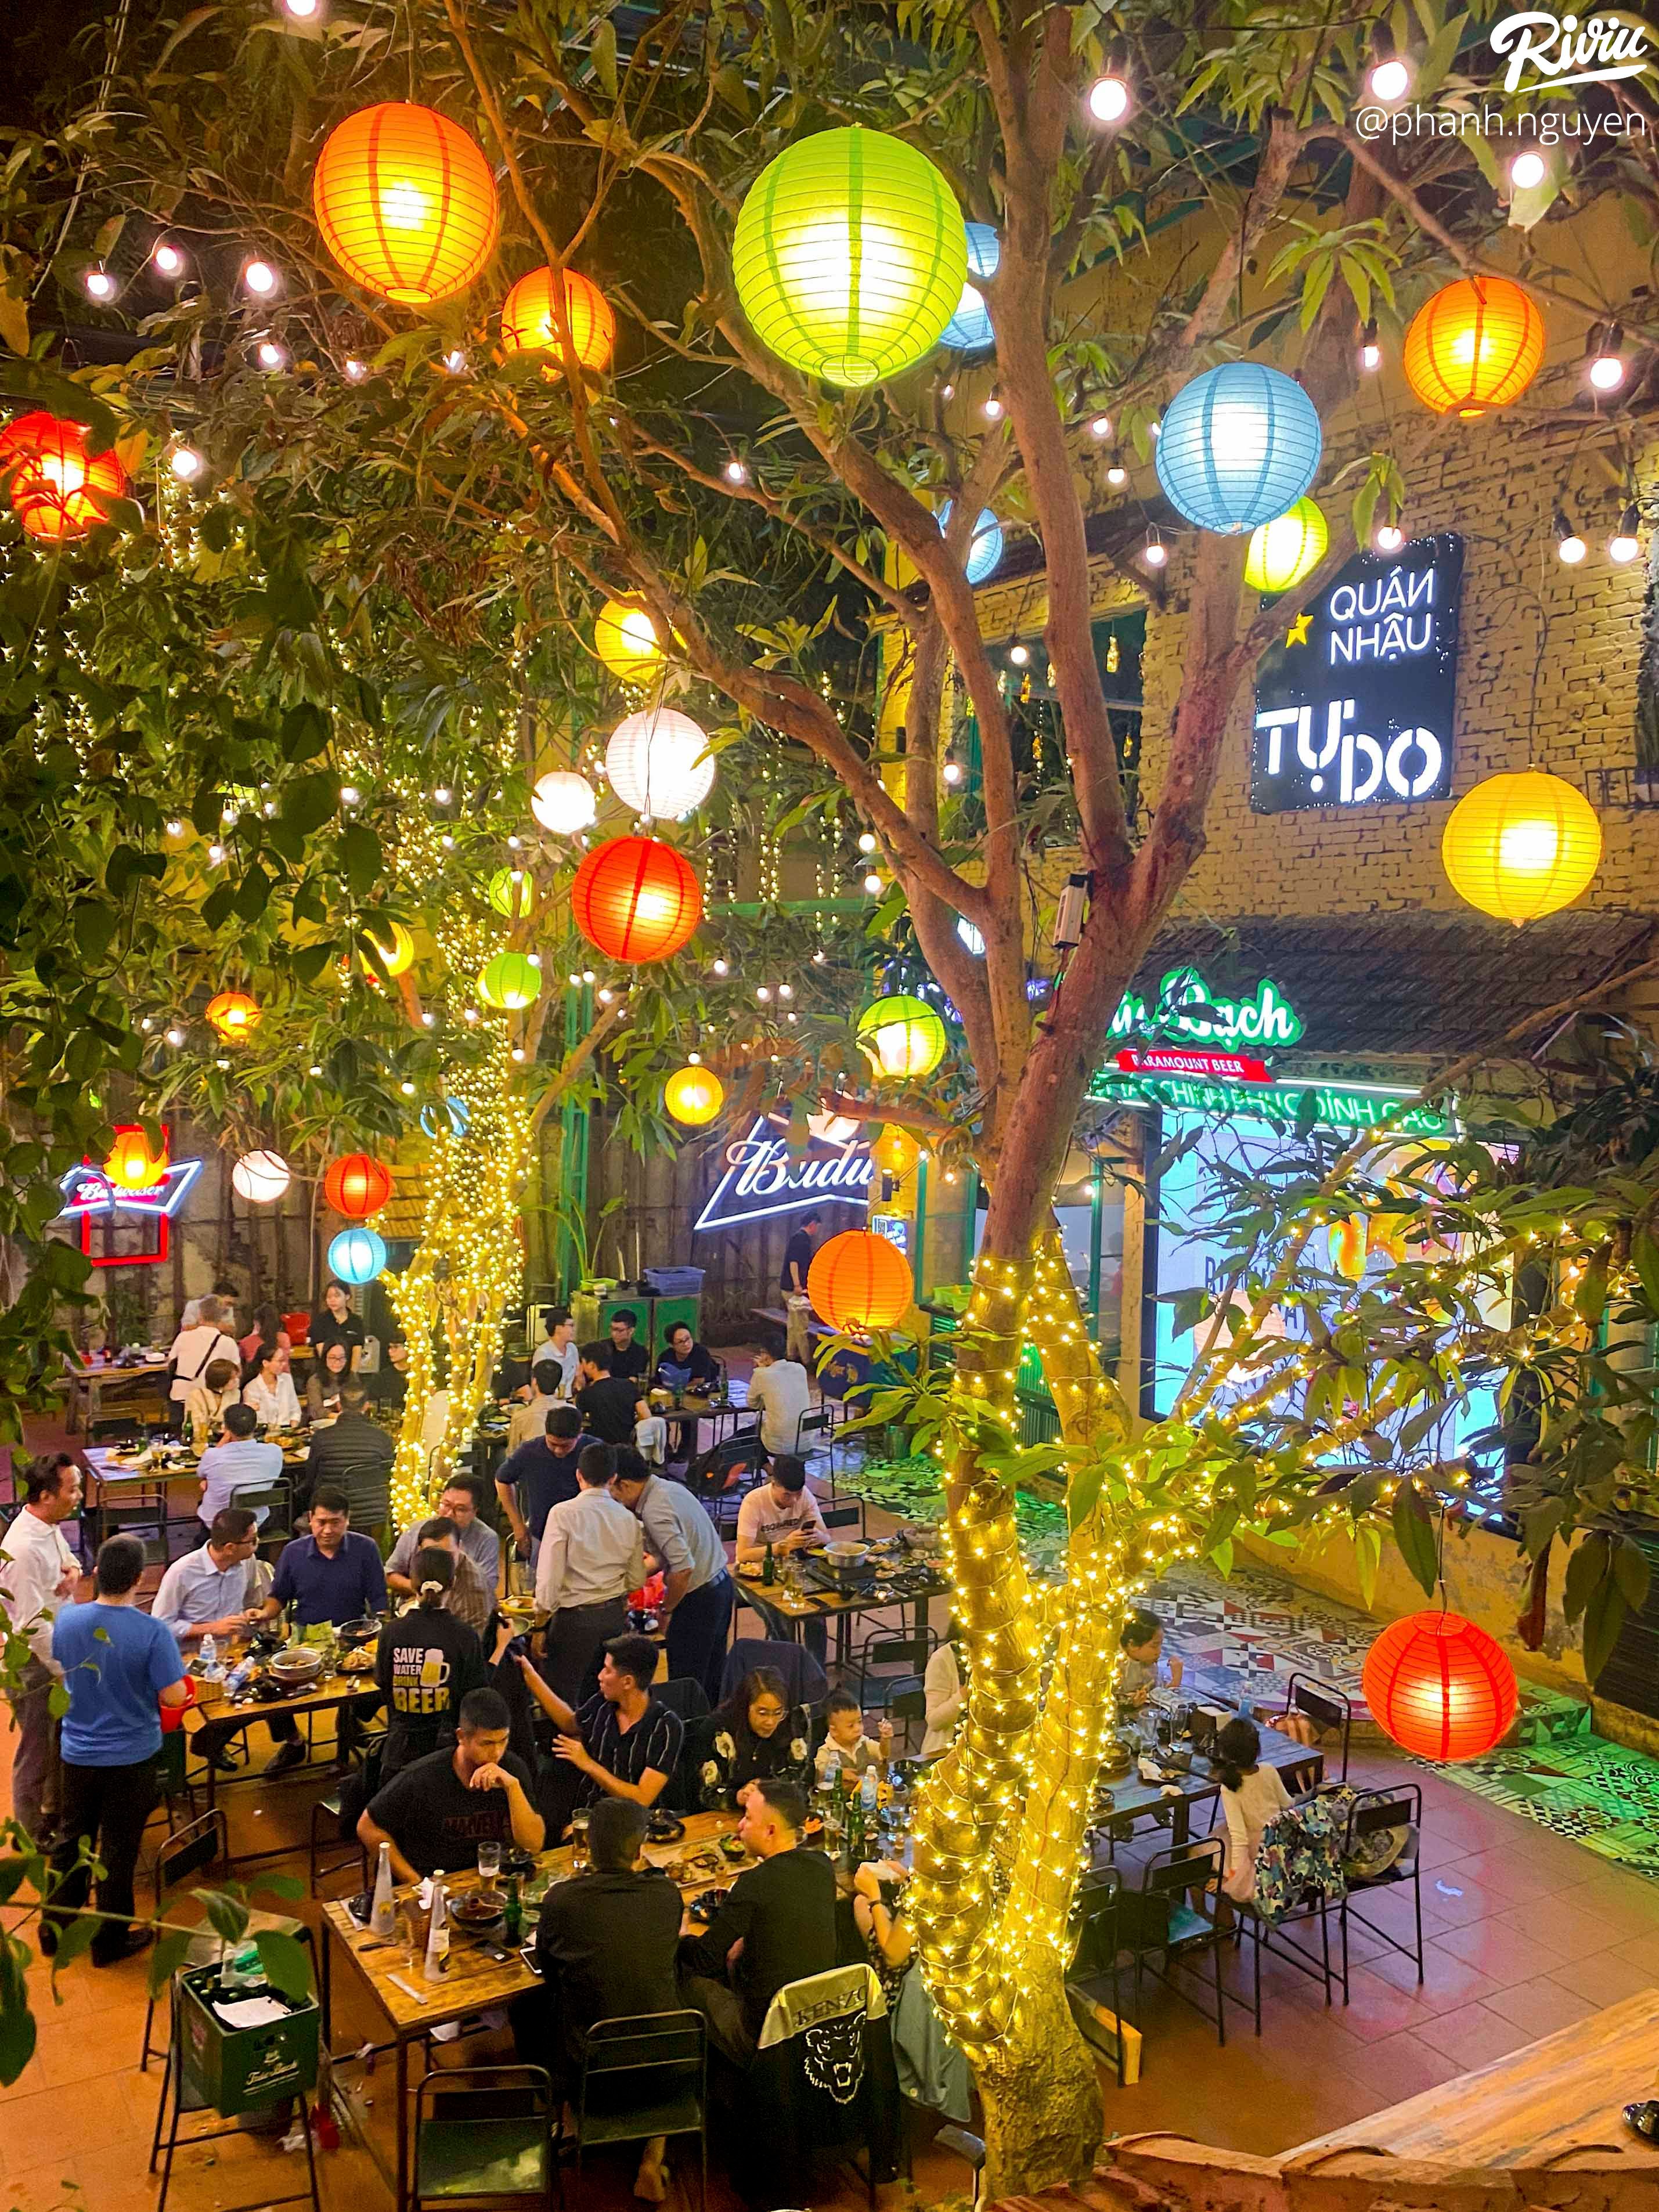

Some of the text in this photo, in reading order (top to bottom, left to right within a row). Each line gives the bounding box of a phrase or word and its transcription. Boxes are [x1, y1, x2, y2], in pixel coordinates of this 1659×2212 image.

[1330, 565, 1434, 621] QUÁN
[1330, 613, 1431, 665] NHẬU
[1340, 726, 1442, 803] DO
[1211, 1059, 1245, 1073] BEER
[393, 1647, 424, 1663] SAVE
[393, 1664, 422, 1675] WATER
[393, 1686, 450, 1714] BEER
